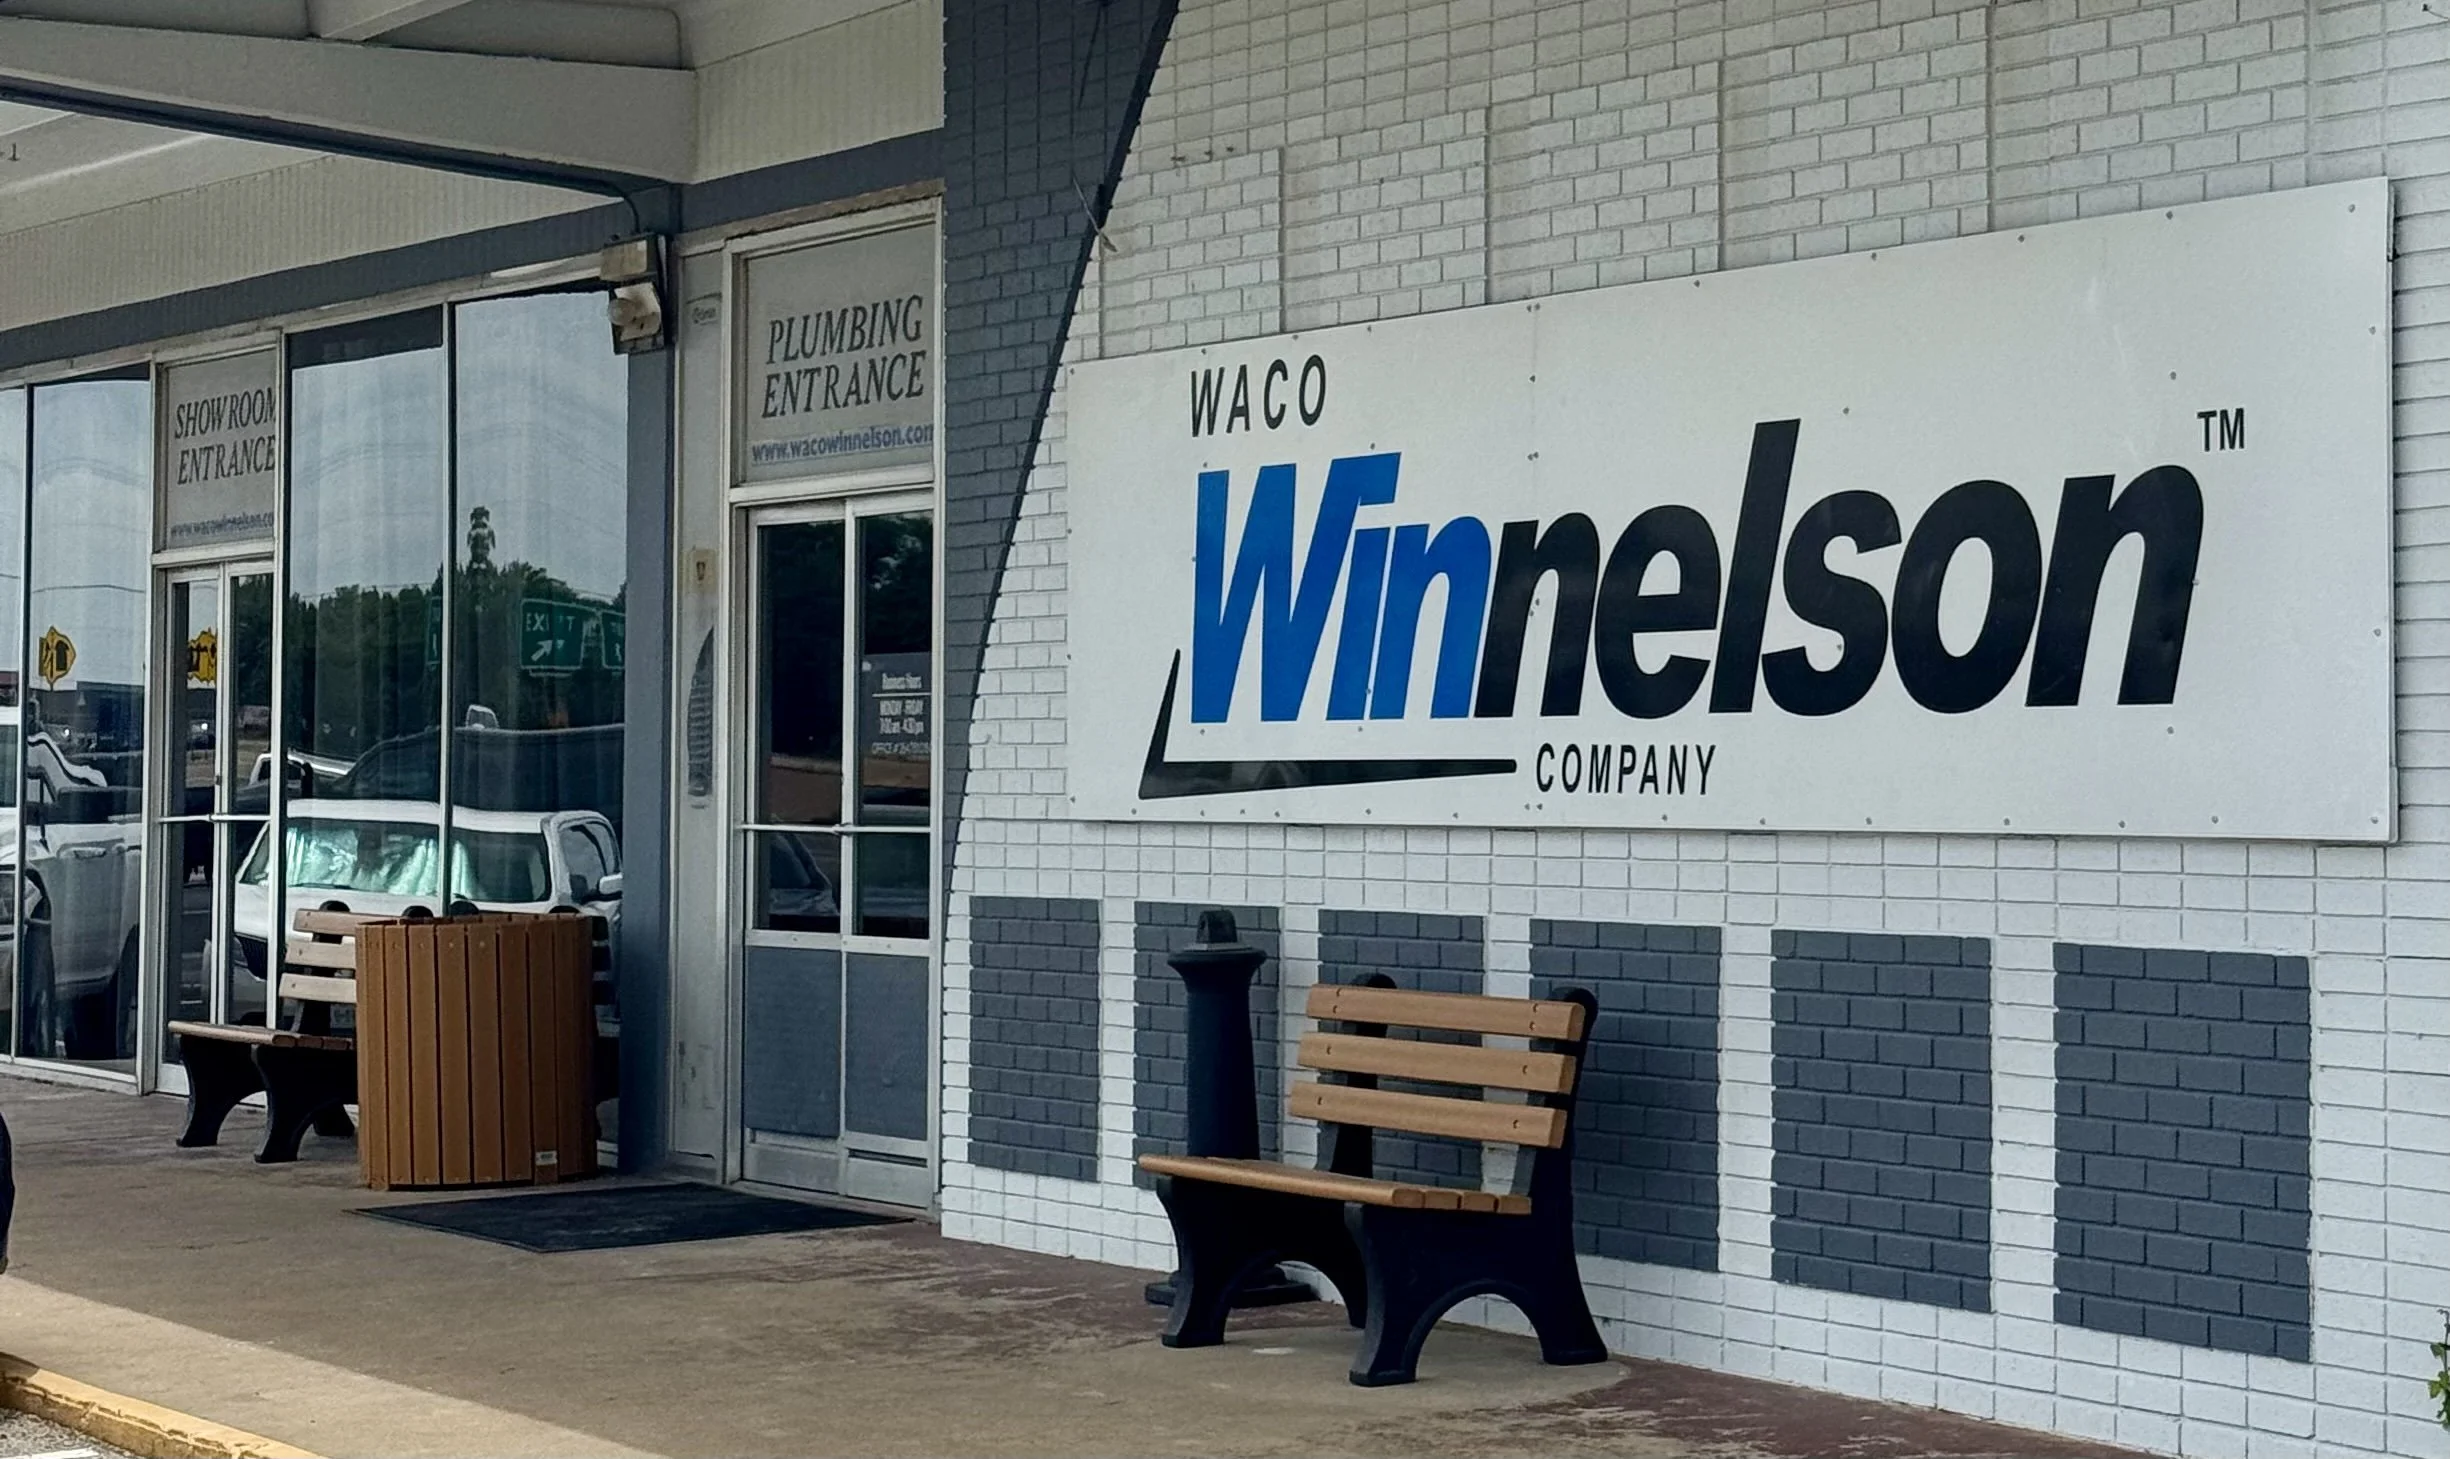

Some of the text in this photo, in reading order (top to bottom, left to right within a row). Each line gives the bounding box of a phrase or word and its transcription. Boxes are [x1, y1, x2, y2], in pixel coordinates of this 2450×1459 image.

[766, 294, 924, 365] PLUMBING
[174, 387, 277, 440] SHOWROOM
[760, 350, 927, 419] ENTRANCE
[1190, 353, 1327, 439] WACO
[176, 433, 276, 486] ENTRANCE
[1190, 419, 2205, 723] Winnelson
[1535, 743, 1717, 796] COMPANY
